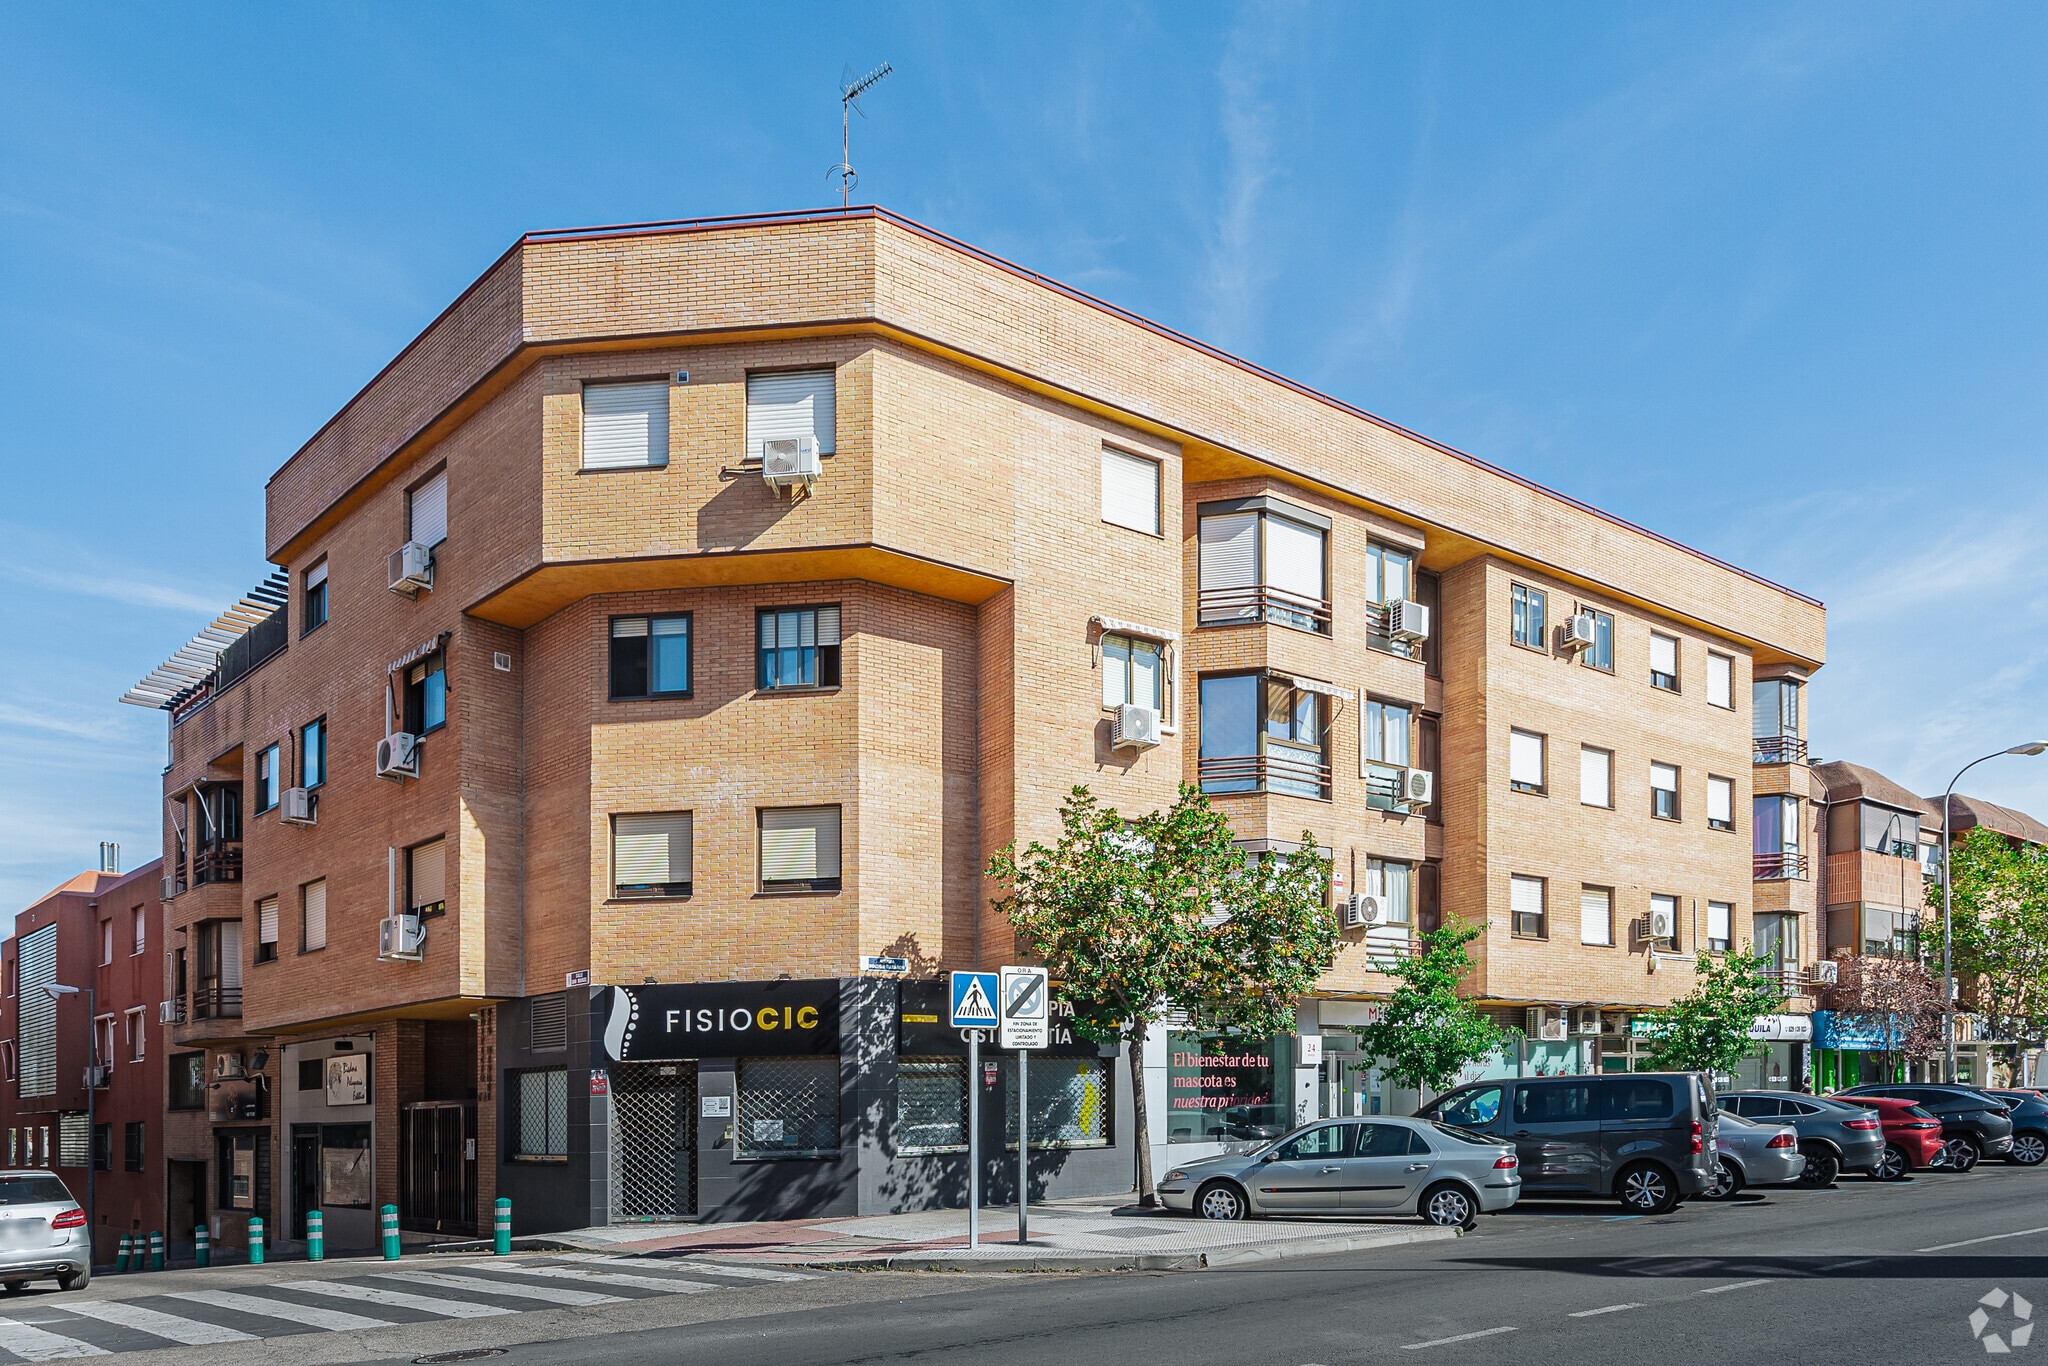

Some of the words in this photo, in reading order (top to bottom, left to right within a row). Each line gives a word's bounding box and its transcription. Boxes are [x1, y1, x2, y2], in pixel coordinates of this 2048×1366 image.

[666, 1006, 819, 1033] FISIOCIC
[1173, 1052, 1185, 1068] El
[1187, 1052, 1240, 1068] bienestar
[1242, 1052, 1256, 1068] de
[1257, 1054, 1270, 1068] tu
[1173, 1074, 1223, 1088] mascota
[1224, 1076, 1237, 1088] es
[1173, 1094, 1216, 1109] nuestra
[1217, 1091, 1270, 1112] prioridad
